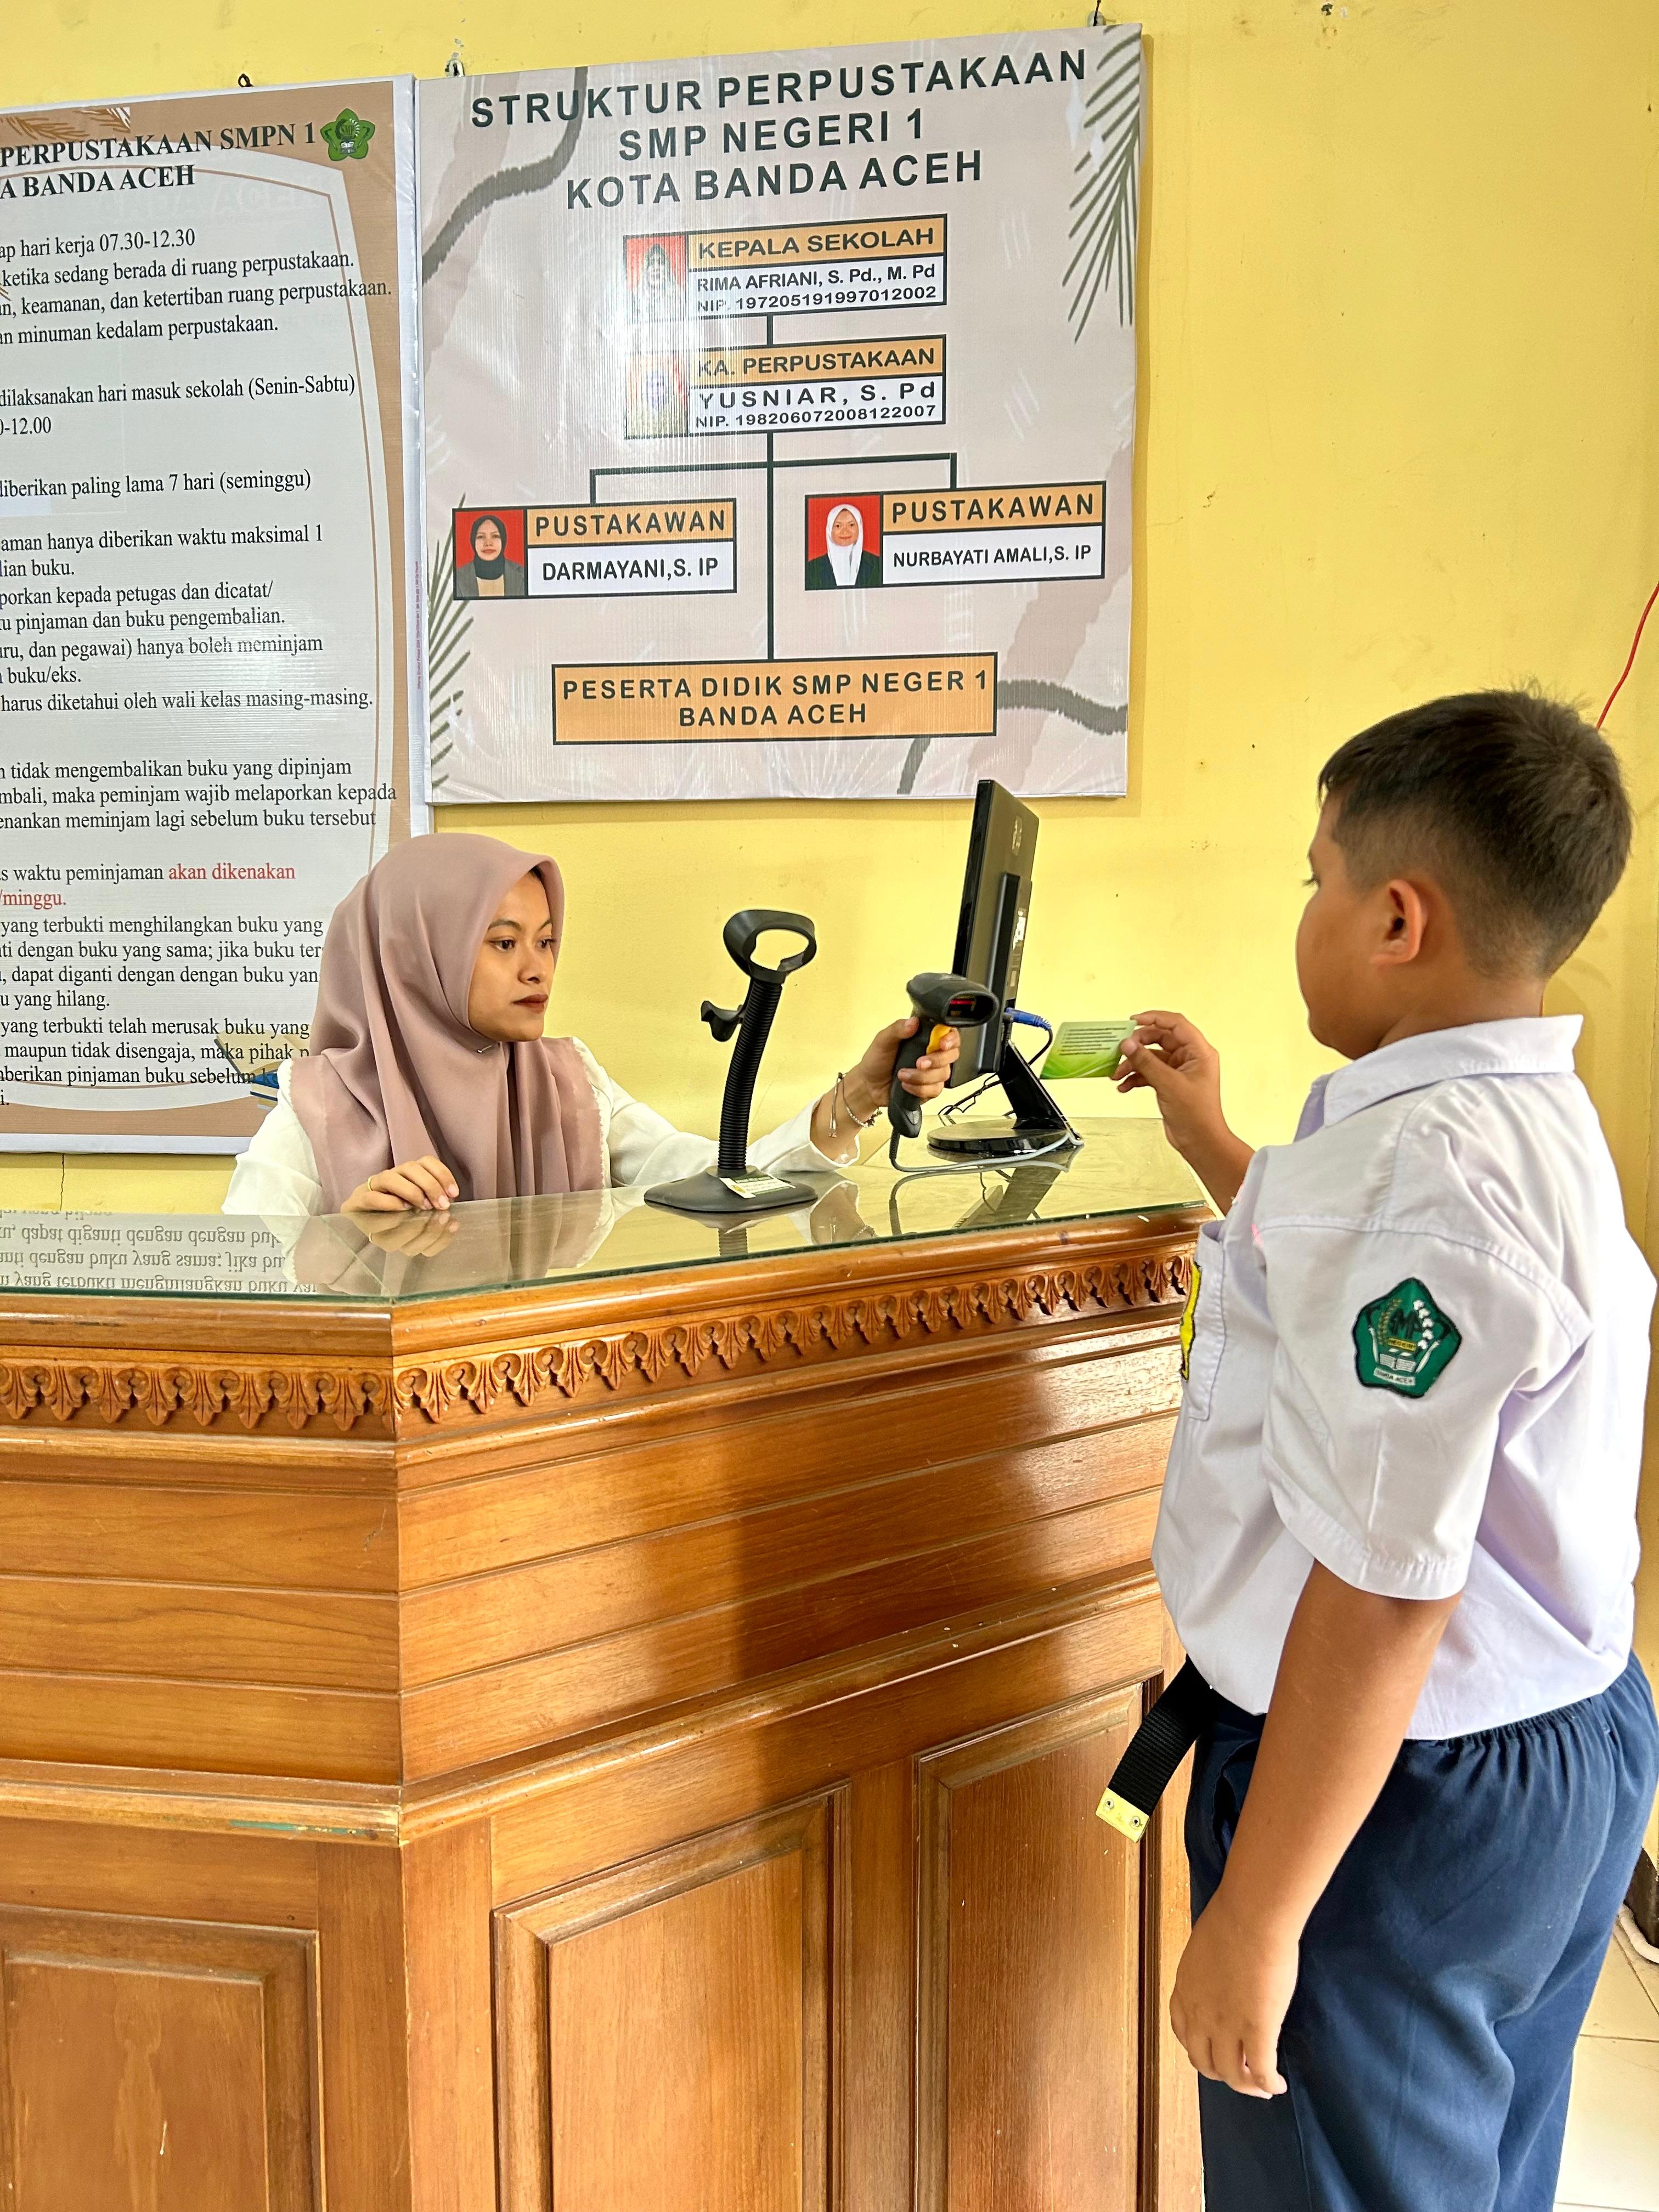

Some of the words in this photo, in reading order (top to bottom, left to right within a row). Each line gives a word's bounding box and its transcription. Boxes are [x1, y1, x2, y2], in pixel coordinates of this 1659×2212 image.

[471, 80, 703, 128] STRUKTUR
[717, 48, 1086, 109] PERPUSTAKAAN
[1, 130, 213, 168] PERPUSTAKAAN
[220, 122, 297, 152] SMPN
[303, 122, 317, 144] 1
[619, 126, 706, 161] SMP
[724, 111, 888, 154] NEGERI
[907, 108, 921, 139] 1
[23, 170, 115, 198] BANDA
[120, 164, 196, 191] ACEH
[568, 173, 680, 210] KOTA
[696, 161, 848, 201] BANDA
[859, 150, 980, 189] ACEH
[20, 239, 50, 257] hari
[55, 237, 95, 258] kerja
[100, 228, 195, 251] 07.30-12.30
[699, 237, 800, 260] KEPALA
[808, 228, 933, 252] SEKOLAH
[2, 268, 50, 288] ketika
[54, 264, 110, 286] sedang
[113, 260, 168, 281] berada
[171, 258, 188, 277] di
[191, 261, 238, 279] ruang
[242, 251, 356, 278] perpustakaan.
[698, 276, 742, 293] RIMA
[746, 272, 823, 290] AFRIANI,
[828, 270, 844, 284] S.
[850, 268, 882, 284] Pd.,
[888, 266, 907, 281] M.
[913, 263, 935, 279] Pd
[21, 297, 105, 315] keamanan,
[111, 292, 139, 311] dan
[144, 287, 224, 307] ketertiban
[228, 289, 275, 307] ruang
[279, 279, 392, 307] perpustakaan.
[736, 286, 936, 310] 197205191997012002
[18, 328, 92, 344] minuman
[96, 319, 164, 340] kedalam
[168, 314, 278, 341] perpustakaan.
[743, 348, 934, 374] PERPUSTAKAAN
[97, 383, 128, 403] hari
[131, 381, 182, 400] masuk
[186, 379, 244, 399] sekolah
[249, 374, 355, 401] (Senin-Sabtu)
[699, 387, 848, 410] YUSNIAR,
[861, 385, 887, 402] S.
[900, 381, 934, 400] Pd
[696, 416, 729, 428] NIP.
[736, 405, 936, 426] 198206072008122007
[71, 477, 121, 500] paling
[126, 475, 165, 493] lama
[169, 474, 178, 492] 7
[183, 473, 215, 490] hari
[220, 469, 311, 494] (seminggu)
[893, 493, 1093, 524] PUSTAKAWAN
[537, 510, 724, 537] PUSTAKAWAN
[47, 533, 95, 554] hanya
[99, 529, 174, 549] diberikan
[177, 528, 227, 546] waktu
[231, 524, 310, 544] maksimal
[316, 524, 323, 541] 1
[699, 557, 718, 577] IP
[894, 549, 989, 568] NURBAYATI
[1075, 545, 1091, 561] IP
[56, 585, 112, 608] kepada
[116, 586, 177, 607] petugas
[182, 583, 211, 600] dan
[215, 580, 274, 600] dicatat/
[15, 613, 89, 636] pinjaman
[93, 611, 121, 629] dan
[125, 610, 166, 628] buku
[169, 607, 285, 631] pengembalian.
[29, 641, 57, 658] dan
[61, 639, 132, 662] pegawai)
[137, 638, 185, 659] hanya
[188, 636, 233, 654] boleh
[237, 635, 324, 657] meminjam
[564, 678, 691, 701] PESERTA
[702, 676, 782, 697] DIDIK
[793, 674, 851, 695] SMP
[862, 671, 964, 694] NEGER
[975, 670, 985, 690] 1
[1, 695, 43, 712] harus
[48, 693, 120, 711] diketahui
[124, 692, 158, 709] oleh
[161, 690, 196, 709] wali
[199, 690, 241, 708] kelas
[245, 688, 374, 712] masing-masing.
[680, 706, 777, 727] BANDA
[788, 703, 866, 725] ACEH
[10, 762, 51, 779] tidak
[55, 760, 183, 782] mengembalikan
[187, 759, 228, 777] buku
[232, 764, 273, 781] yang
[278, 758, 352, 780] dipinjam
[52, 787, 96, 804] maka
[100, 785, 181, 808] peminjam
[184, 783, 230, 806] wajib
[234, 783, 333, 806] melaporkan
[337, 782, 400, 806] kepada
[65, 811, 151, 833] meminjam
[155, 810, 186, 832] lagi
[191, 809, 259, 827] sebelum
[263, 809, 305, 826] buku
[309, 808, 377, 827] tersebut
[13, 864, 62, 881] waktu
[66, 864, 165, 886] peminjaman
[169, 863, 207, 880] akan
[212, 862, 297, 880] dikenakan
[1, 922, 39, 938] yang
[43, 916, 104, 933] terbukti
[109, 916, 233, 937] menghilangkan
[237, 916, 279, 933] buku
[283, 921, 324, 937] yang
[18, 941, 74, 962] dengan
[78, 941, 119, 958] buku
[122, 946, 162, 962] yang
[167, 946, 213, 961] sama;
[217, 941, 250, 962] jika
[253, 941, 295, 958] buku
[12, 966, 54, 986] dapat
[59, 966, 113, 986] diganti
[118, 966, 176, 986] dengan
[180, 966, 239, 987] dengan
[242, 966, 285, 983] buku
[14, 995, 53, 1011] yang
[57, 990, 110, 1011] hilang.
[0, 1022, 39, 1038] yang
[43, 1017, 104, 1034] terbukti
[108, 1017, 148, 1034] telah
[151, 1017, 221, 1035] merusak
[224, 1018, 266, 1035] buku
[269, 1024, 310, 1040] yang
[4, 1046, 68, 1063] maupun
[71, 1042, 112, 1058] tidak
[116, 1042, 195, 1063] disengaja,
[200, 1043, 245, 1060] maka
[249, 1043, 295, 1064] pihak
[67, 1065, 142, 1087] pinjaman
[144, 1066, 185, 1084] buku
[189, 1067, 257, 1085] sebelum
